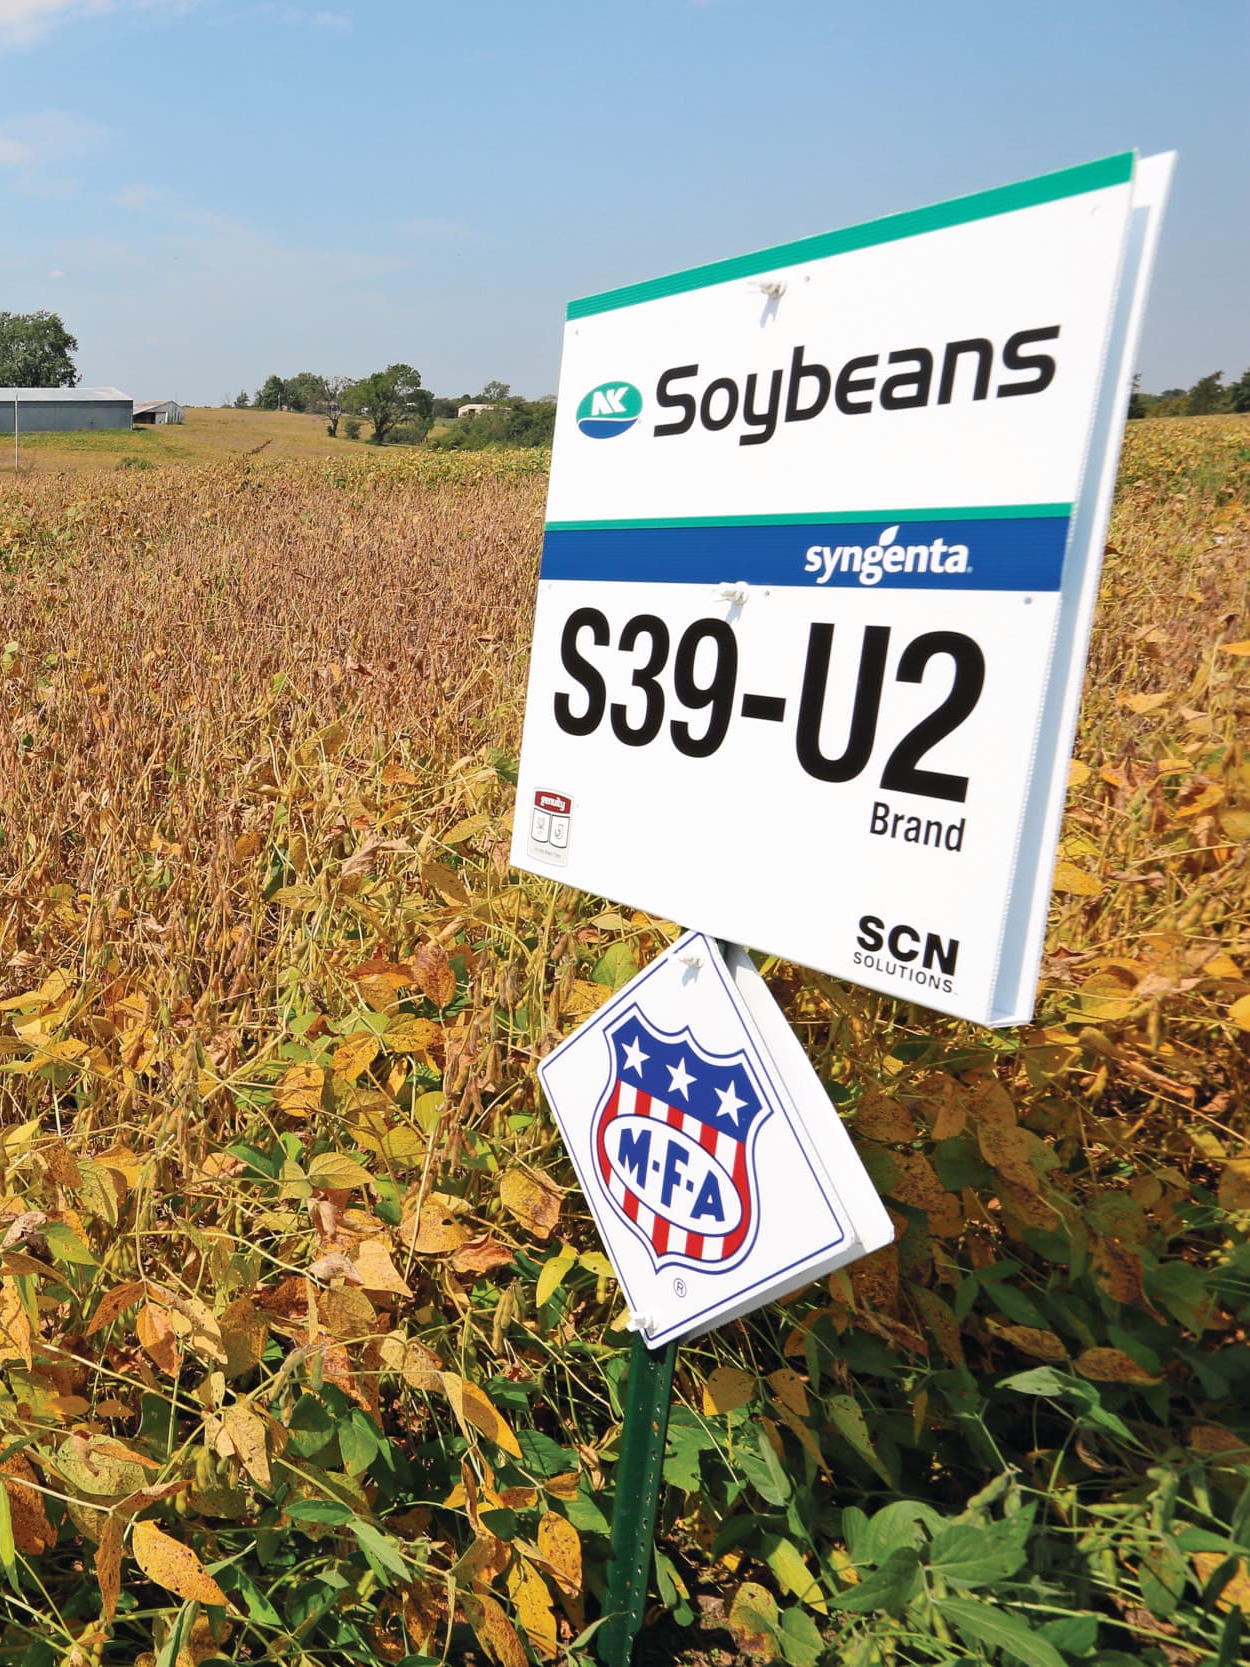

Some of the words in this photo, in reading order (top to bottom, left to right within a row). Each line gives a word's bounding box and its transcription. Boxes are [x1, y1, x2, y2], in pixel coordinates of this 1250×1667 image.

[591, 386, 629, 416] NK
[654, 326, 1060, 446] Soybeans
[804, 537, 969, 585] syngenta
[554, 607, 986, 803] S39-U2
[869, 801, 965, 852] Brand
[853, 951, 953, 993] SOLUTIONS
[857, 915, 959, 976] SCN
